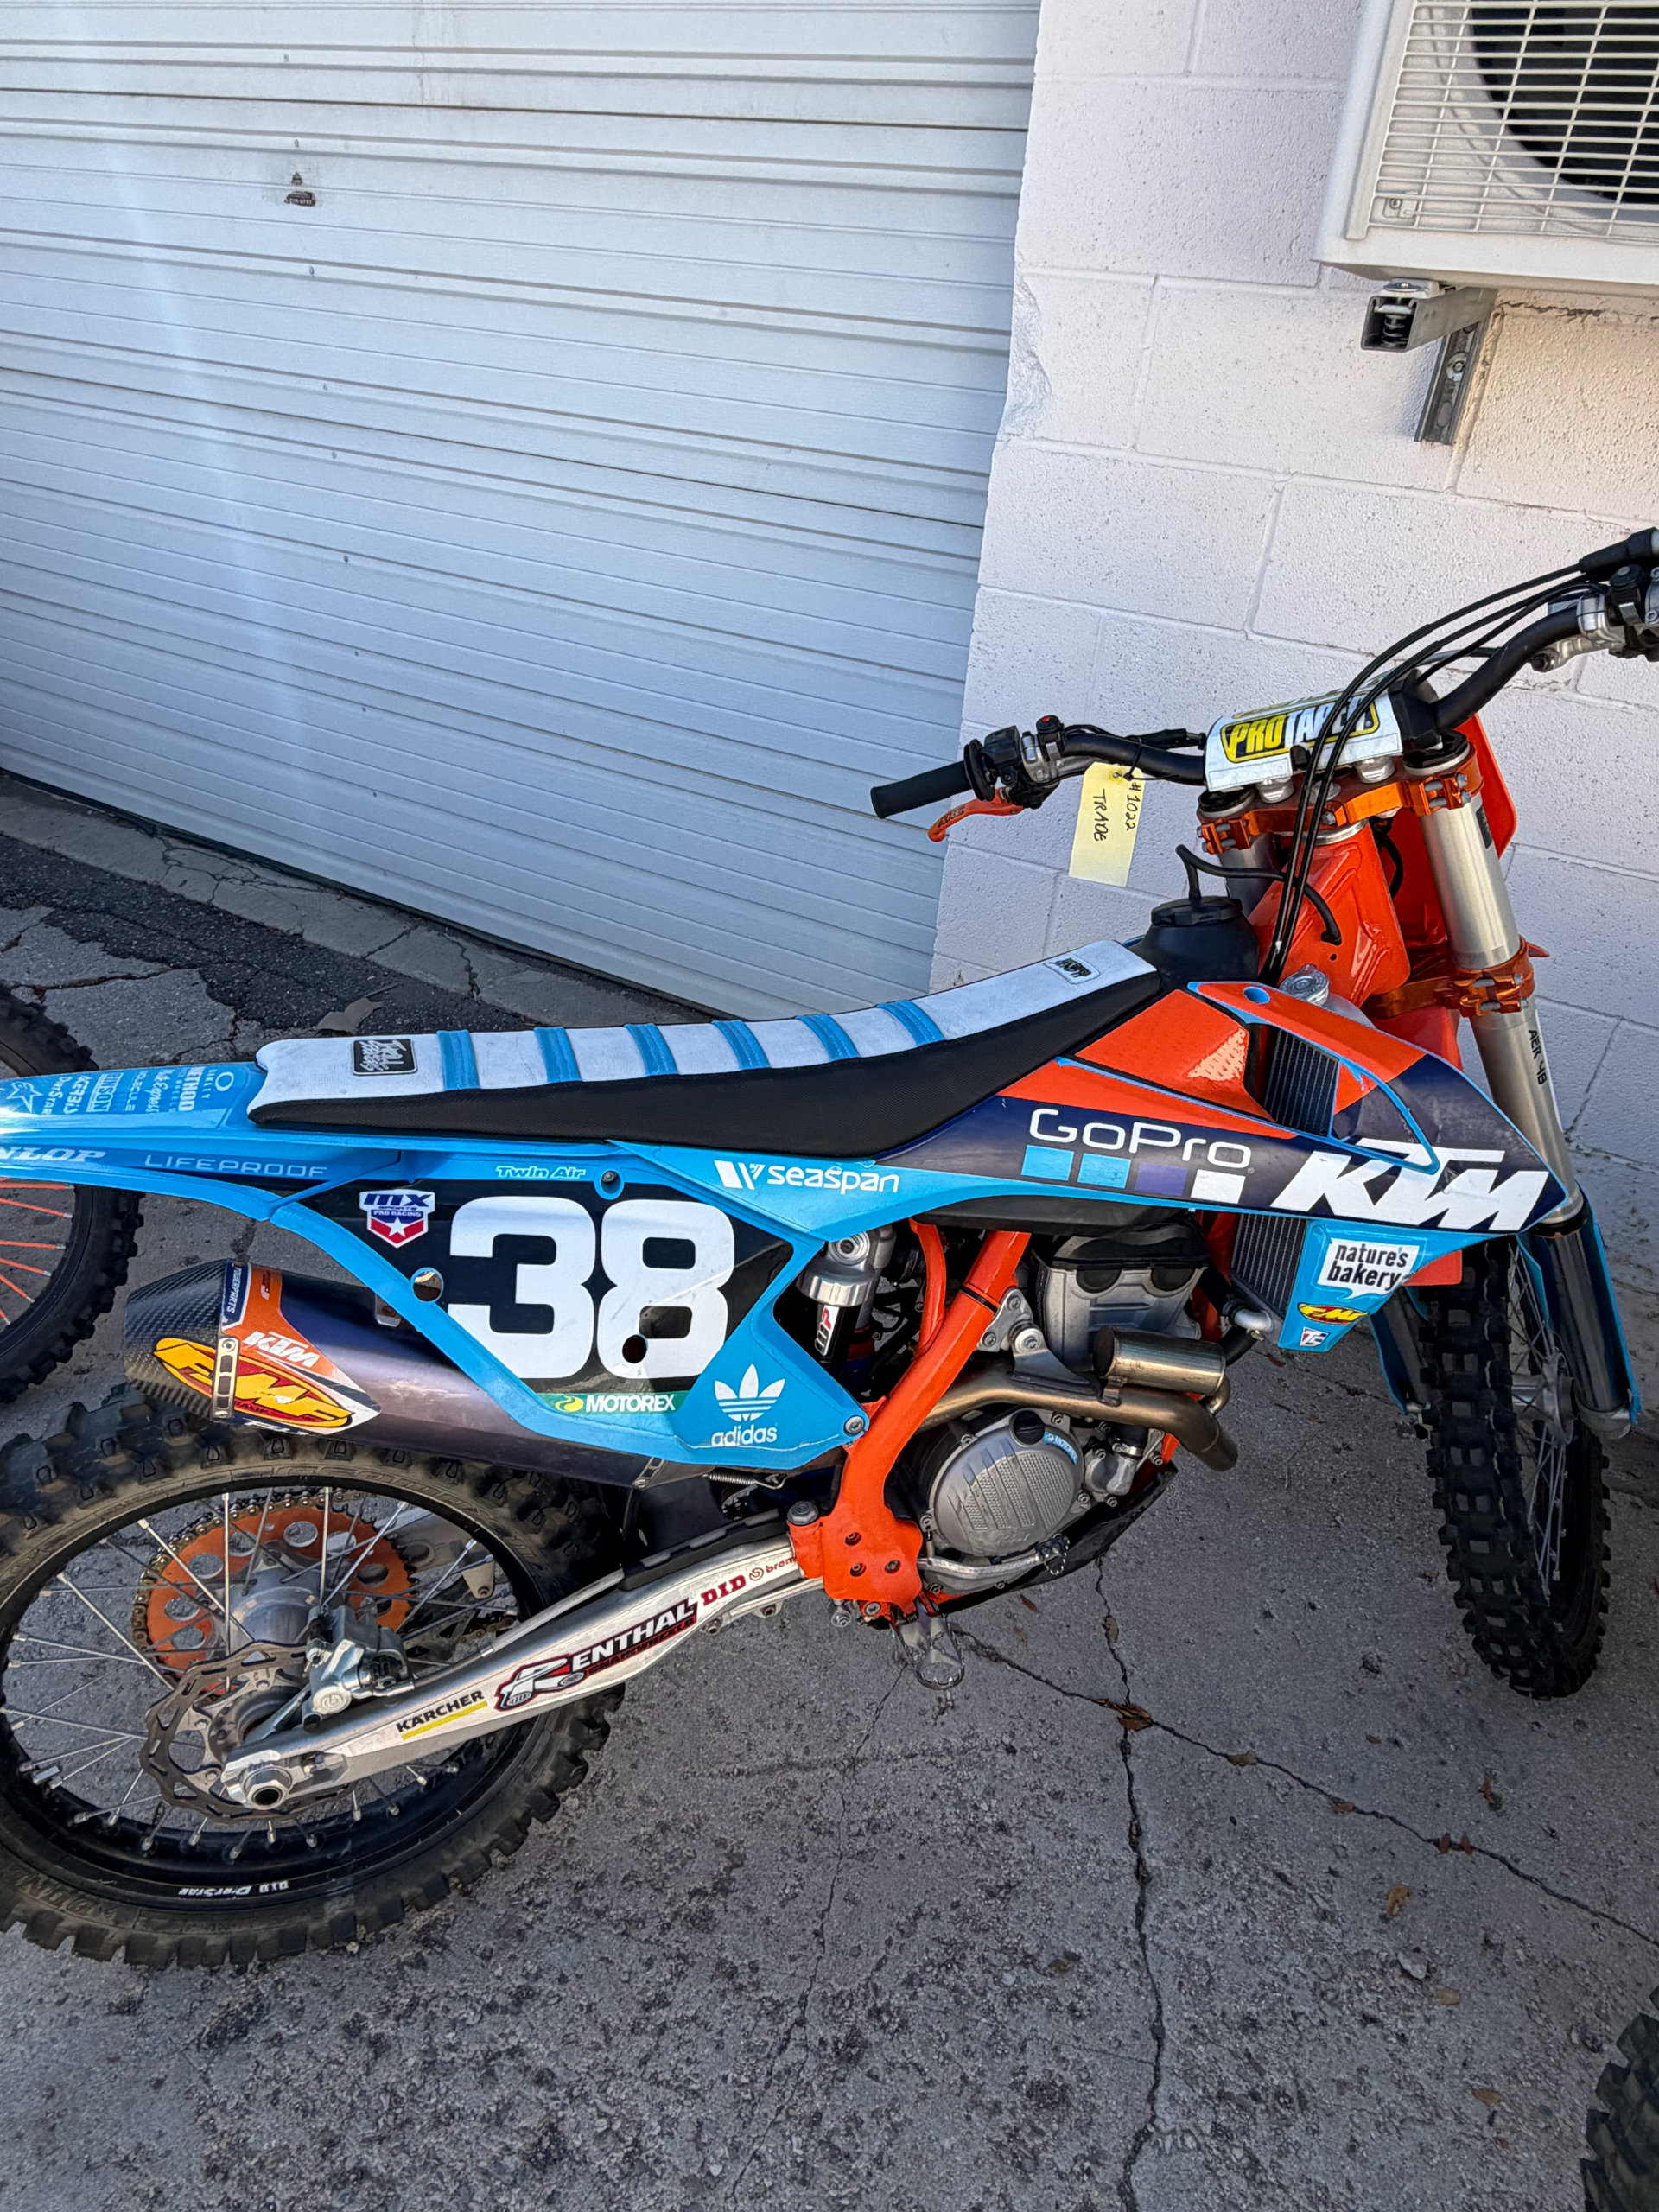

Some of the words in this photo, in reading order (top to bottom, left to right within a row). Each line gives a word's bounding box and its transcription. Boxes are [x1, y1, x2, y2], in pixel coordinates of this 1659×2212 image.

[1092, 788, 1109, 842] TRADE
[1528, 1029, 1542, 1059] AER
[0, 1146, 106, 1162] NLOP
[144, 1154, 328, 1178] LIFEPROOF
[496, 1166, 549, 1179] Twin
[549, 1166, 587, 1179] Air
[767, 1166, 899, 1195] seaspan
[1269, 1138, 1549, 1232] KTM
[448, 1196, 734, 1379] 38
[1327, 1260, 1402, 1291] bakery
[243, 1331, 320, 1368] KTM
[586, 1395, 676, 1412] MOTOREX
[711, 1424, 778, 1447] adidas
[766, 1554, 798, 1573] brem
[396, 1690, 485, 1733] KÄRCHER
